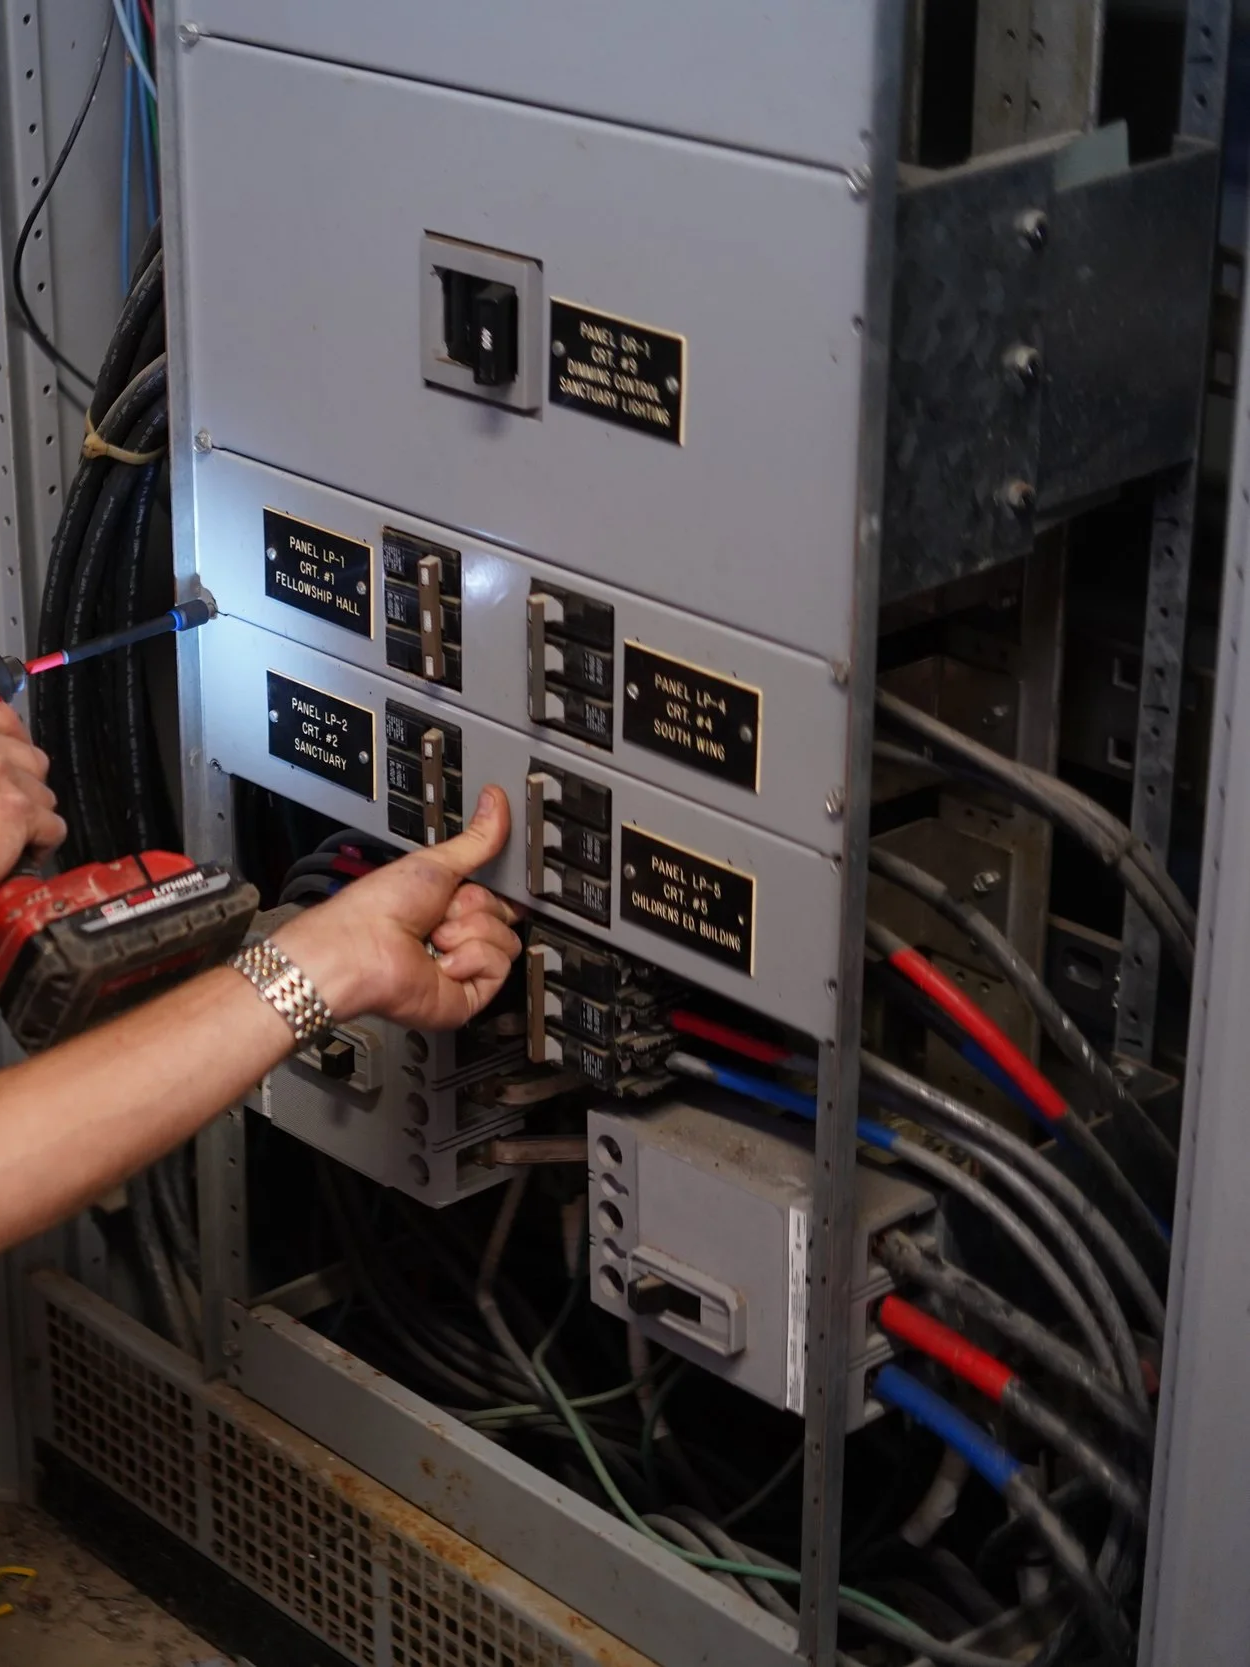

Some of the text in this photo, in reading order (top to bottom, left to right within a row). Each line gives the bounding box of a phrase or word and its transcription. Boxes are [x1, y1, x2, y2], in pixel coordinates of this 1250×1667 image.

[579, 320, 617, 349] PANEL
[559, 374, 671, 427] SANCTUARY LIGHTING
[613, 373, 662, 404] CONTROL
[289, 535, 345, 569] PANEL LP-1
[300, 560, 335, 586] CRT. #1
[275, 570, 332, 604] FELLOWSHIP
[335, 595, 361, 617] HALL
[654, 672, 727, 717] PANEL LP-4
[291, 697, 348, 733] PANEL LP-2
[665, 698, 713, 735] CRT. #4
[301, 721, 338, 749] CRT. #2
[653, 716, 726, 762] SOUTH WING
[294, 737, 347, 771] SANCTUARY
[152, 871, 204, 897] LITHIUM
[651, 854, 722, 901] PANEL LP-5
[663, 884, 709, 917] CRT. #5
[631, 891, 680, 926] CHILDRENS
[682, 915, 698, 934] ED.
[699, 921, 742, 954] BUILDING
